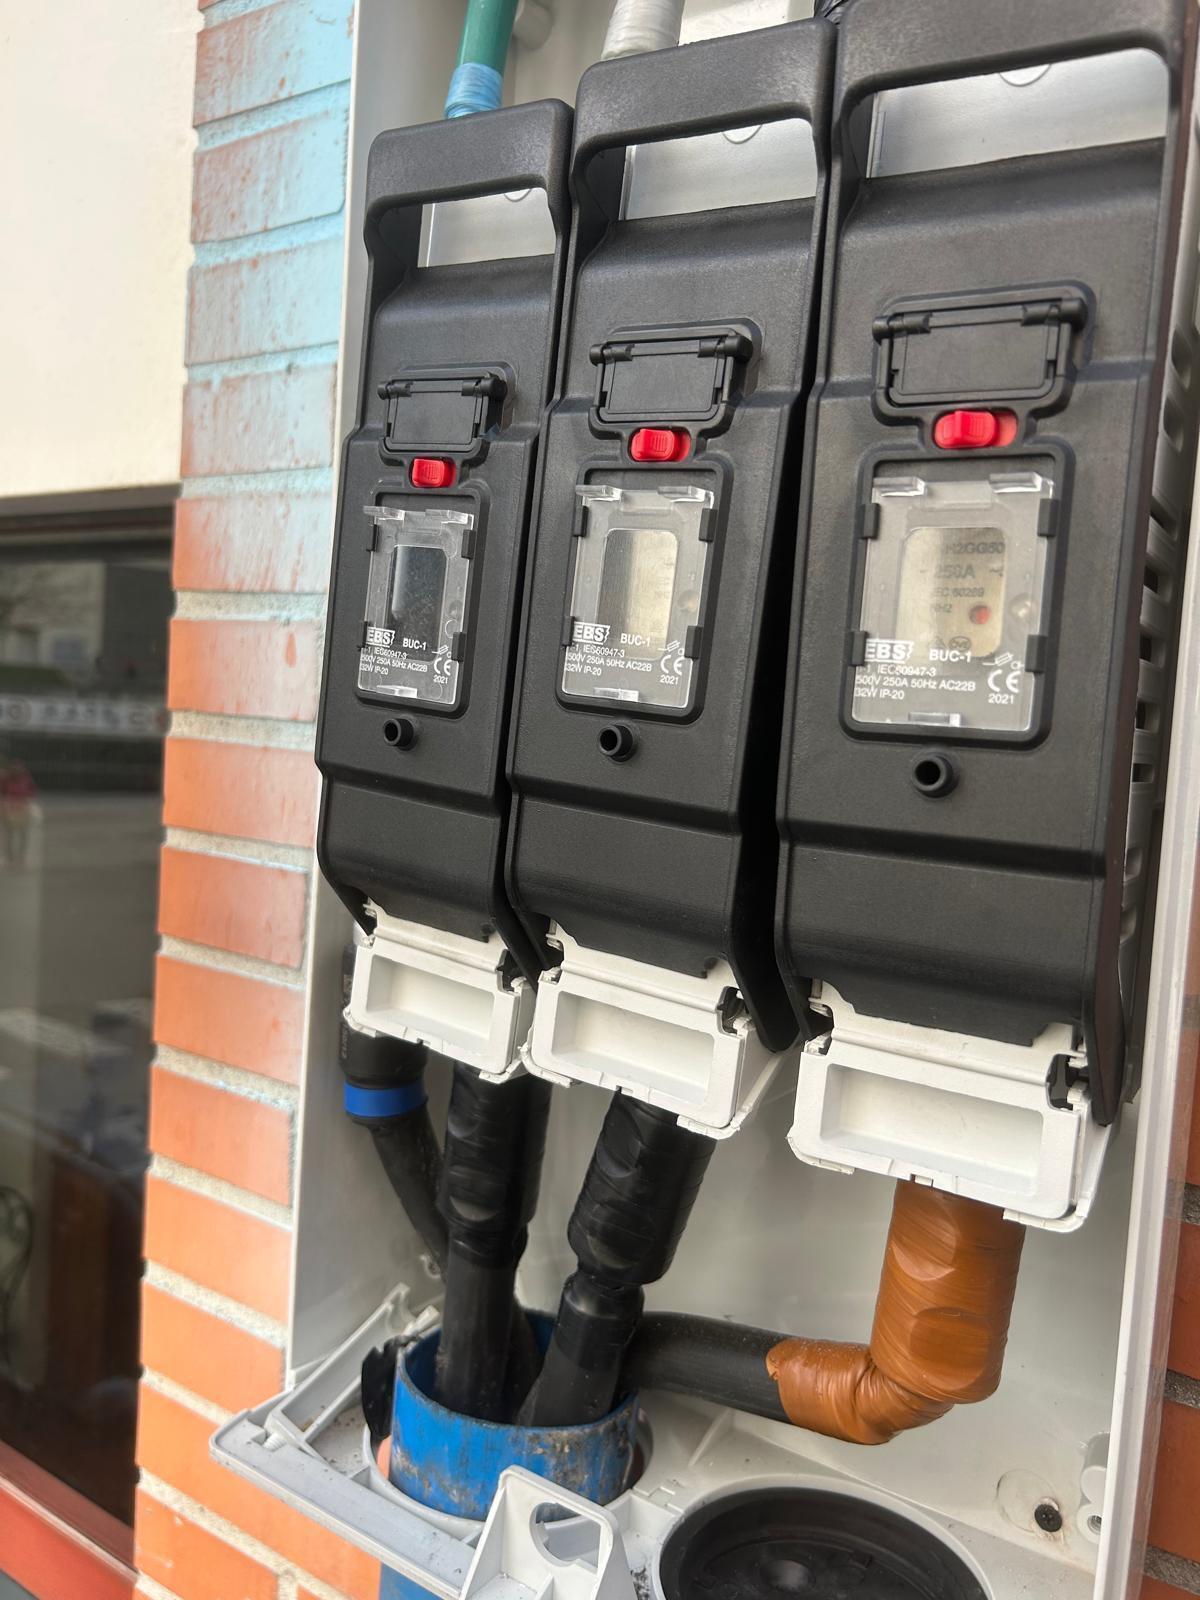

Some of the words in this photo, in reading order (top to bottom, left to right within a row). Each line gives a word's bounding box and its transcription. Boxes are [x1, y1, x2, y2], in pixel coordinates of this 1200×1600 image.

[366, 627, 392, 647] EBS
[403, 638, 426, 650] BUC-1
[574, 622, 608, 644] EBS
[620, 633, 650, 646] BUC-1
[865, 640, 909, 663] EBS
[929, 649, 972, 663] BUC-1
[586, 656, 604, 666] 250A
[606, 660, 624, 668] 50Hz
[626, 662, 652, 672] AC22B
[878, 664, 936, 676] IEC60947-3
[433, 674, 448, 684] 2021
[660, 675, 679, 685] 2021
[856, 674, 880, 686] 500V
[883, 677, 908, 688] 250A
[910, 679, 937, 690] 50Hz
[940, 681, 976, 692] AC22B
[880, 689, 905, 700] IP-20
[988, 694, 1014, 704] 2021
